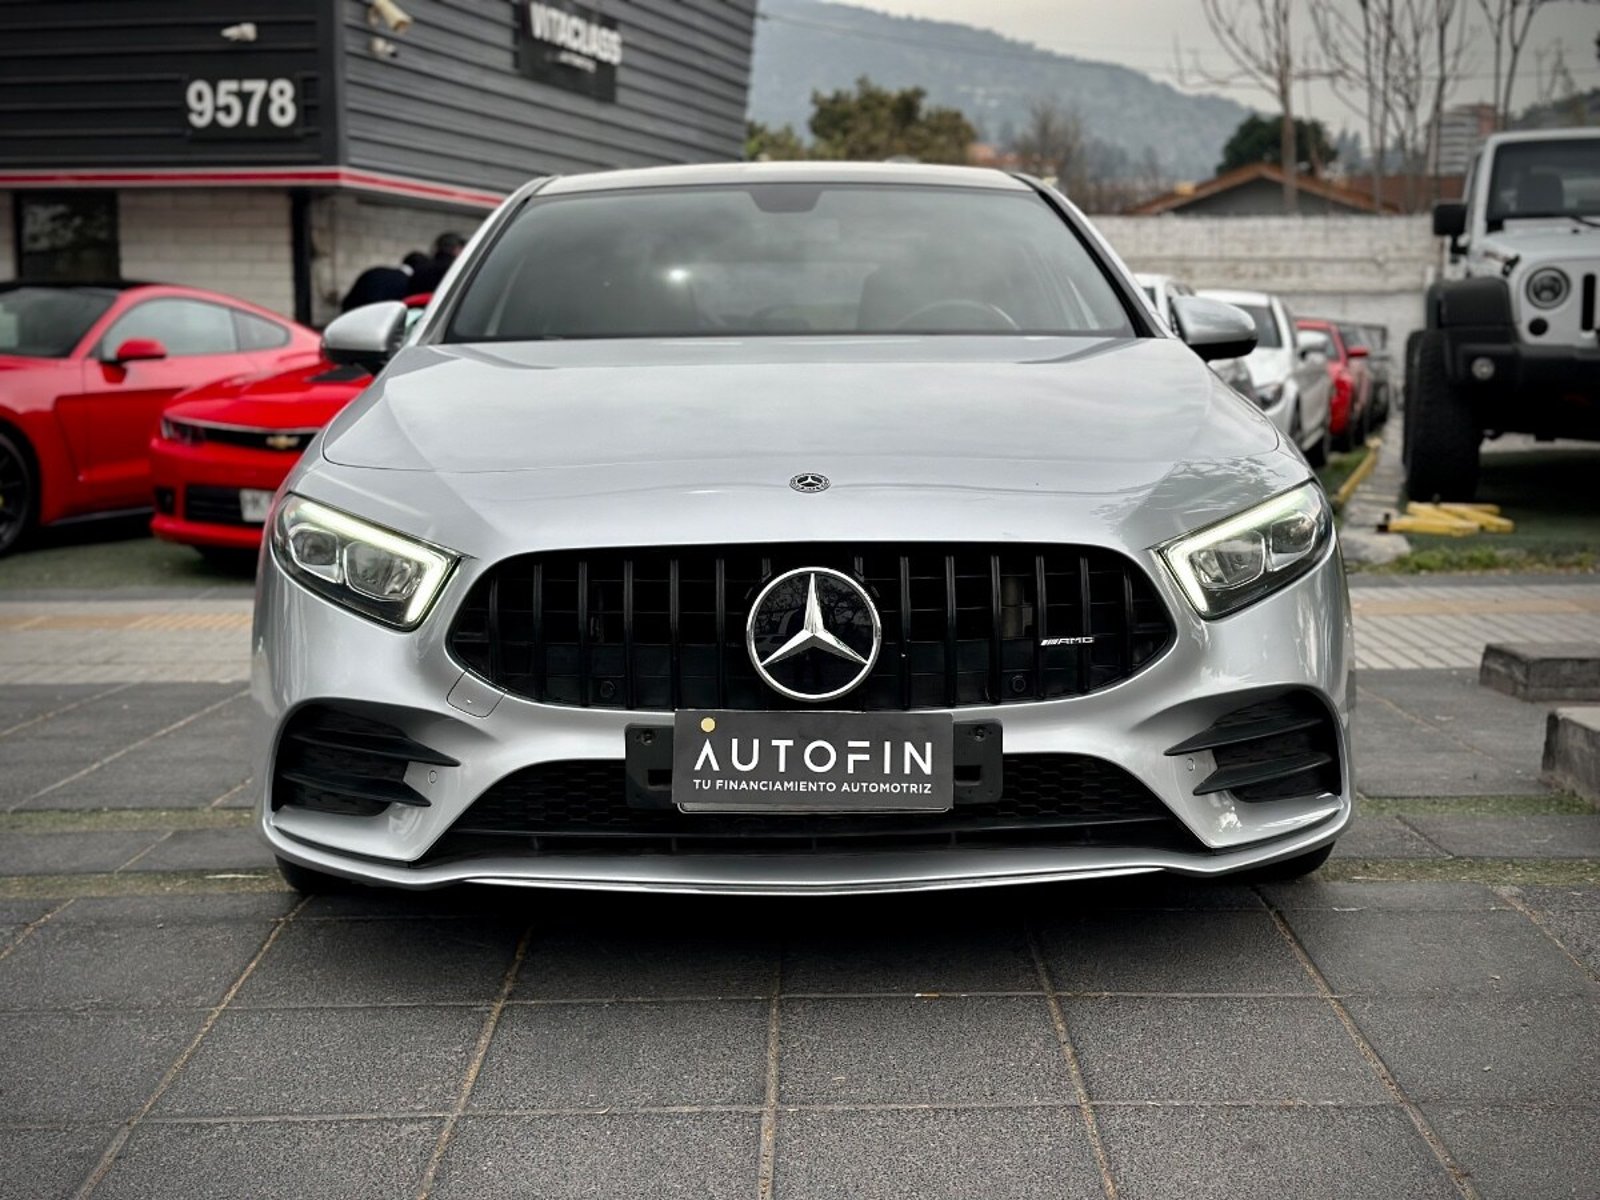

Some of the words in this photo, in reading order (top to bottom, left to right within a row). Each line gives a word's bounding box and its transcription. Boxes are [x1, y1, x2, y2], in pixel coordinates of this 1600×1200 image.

[186, 78, 297, 128] 9578
[1057, 637, 1094, 645] AMG
[694, 738, 933, 775] AUTOFIN
[693, 779, 711, 790] TU
[715, 779, 837, 793] FINANCIAMIENTO
[840, 782, 932, 794] AUTOMOTRIZ
